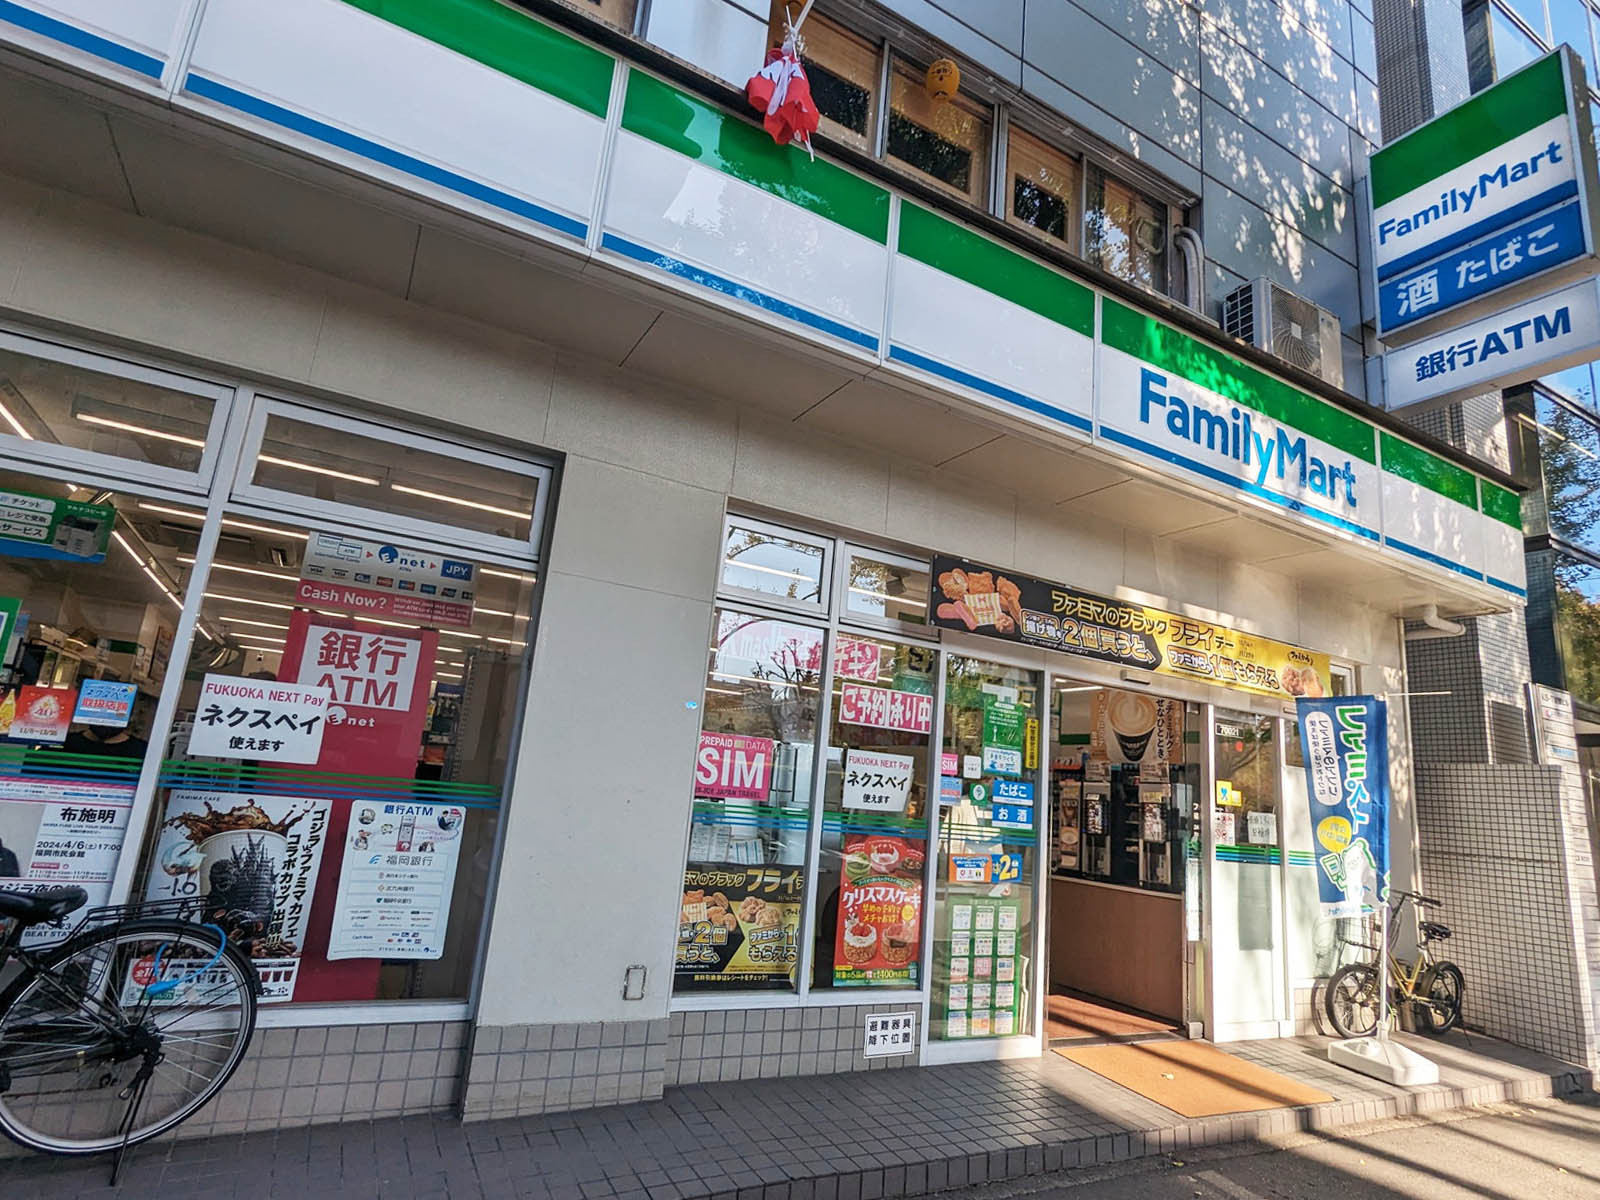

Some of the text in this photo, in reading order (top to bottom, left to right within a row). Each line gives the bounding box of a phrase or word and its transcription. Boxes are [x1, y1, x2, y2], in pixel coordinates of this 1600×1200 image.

[1379, 141, 1562, 246] FamilyMart
[1398, 224, 1559, 317] 酒 たばこ
[1416, 306, 1572, 382] 銀行ATM
[1140, 366, 1357, 508] FamilyMart
[0, 522, 42, 537] サービス
[446, 564, 469, 577] JPY
[301, 585, 339, 602] Cash
[344, 591, 387, 609] Now?
[317, 631, 407, 677] 銀行
[205, 683, 325, 707] FUKUOKA NEXT Pay
[317, 672, 399, 708] ATM
[200, 703, 321, 735] ネクスペイ
[843, 688, 931, 732] ご予約承り中
[229, 736, 285, 752] 使えます
[700, 735, 766, 752] PREPAID DATA
[696, 746, 765, 789] SIM
[848, 755, 910, 771] FUKUOKA NEXT Pay
[942, 759, 958, 771] SIM
[847, 771, 909, 791] ネクスペイ
[999, 782, 1028, 798] たばこ
[863, 794, 890, 805] 使えます
[60, 806, 116, 824] 布施明
[384, 804, 434, 817] 銀行ATM
[386, 855, 433, 867] 福岡銀行
[842, 886, 921, 910] クリスマスケーキ
[25, 930, 48, 938] BEAT
[749, 945, 798, 963] もらえる
[869, 1017, 911, 1033] 避難器具
[868, 1031, 911, 1046] 降下位置
